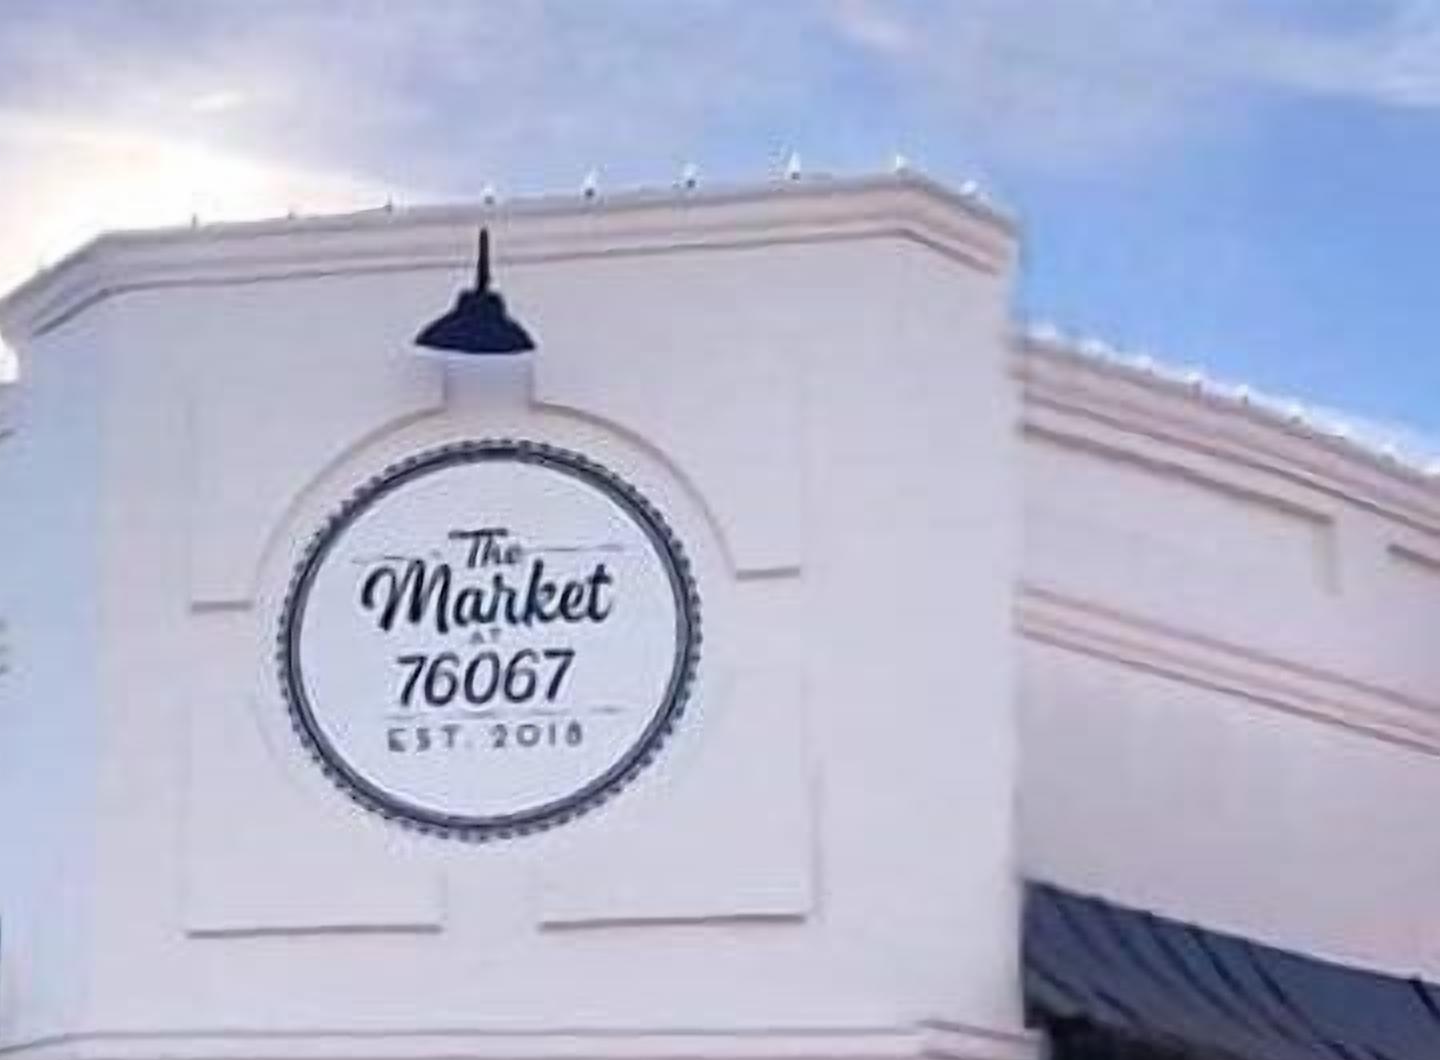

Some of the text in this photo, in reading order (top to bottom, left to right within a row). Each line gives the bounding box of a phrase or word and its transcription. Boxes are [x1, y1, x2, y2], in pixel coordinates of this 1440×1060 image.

[448, 527, 523, 568] The
[361, 559, 614, 634] Market
[396, 648, 576, 707] 76067
[491, 722, 584, 749] 2018
